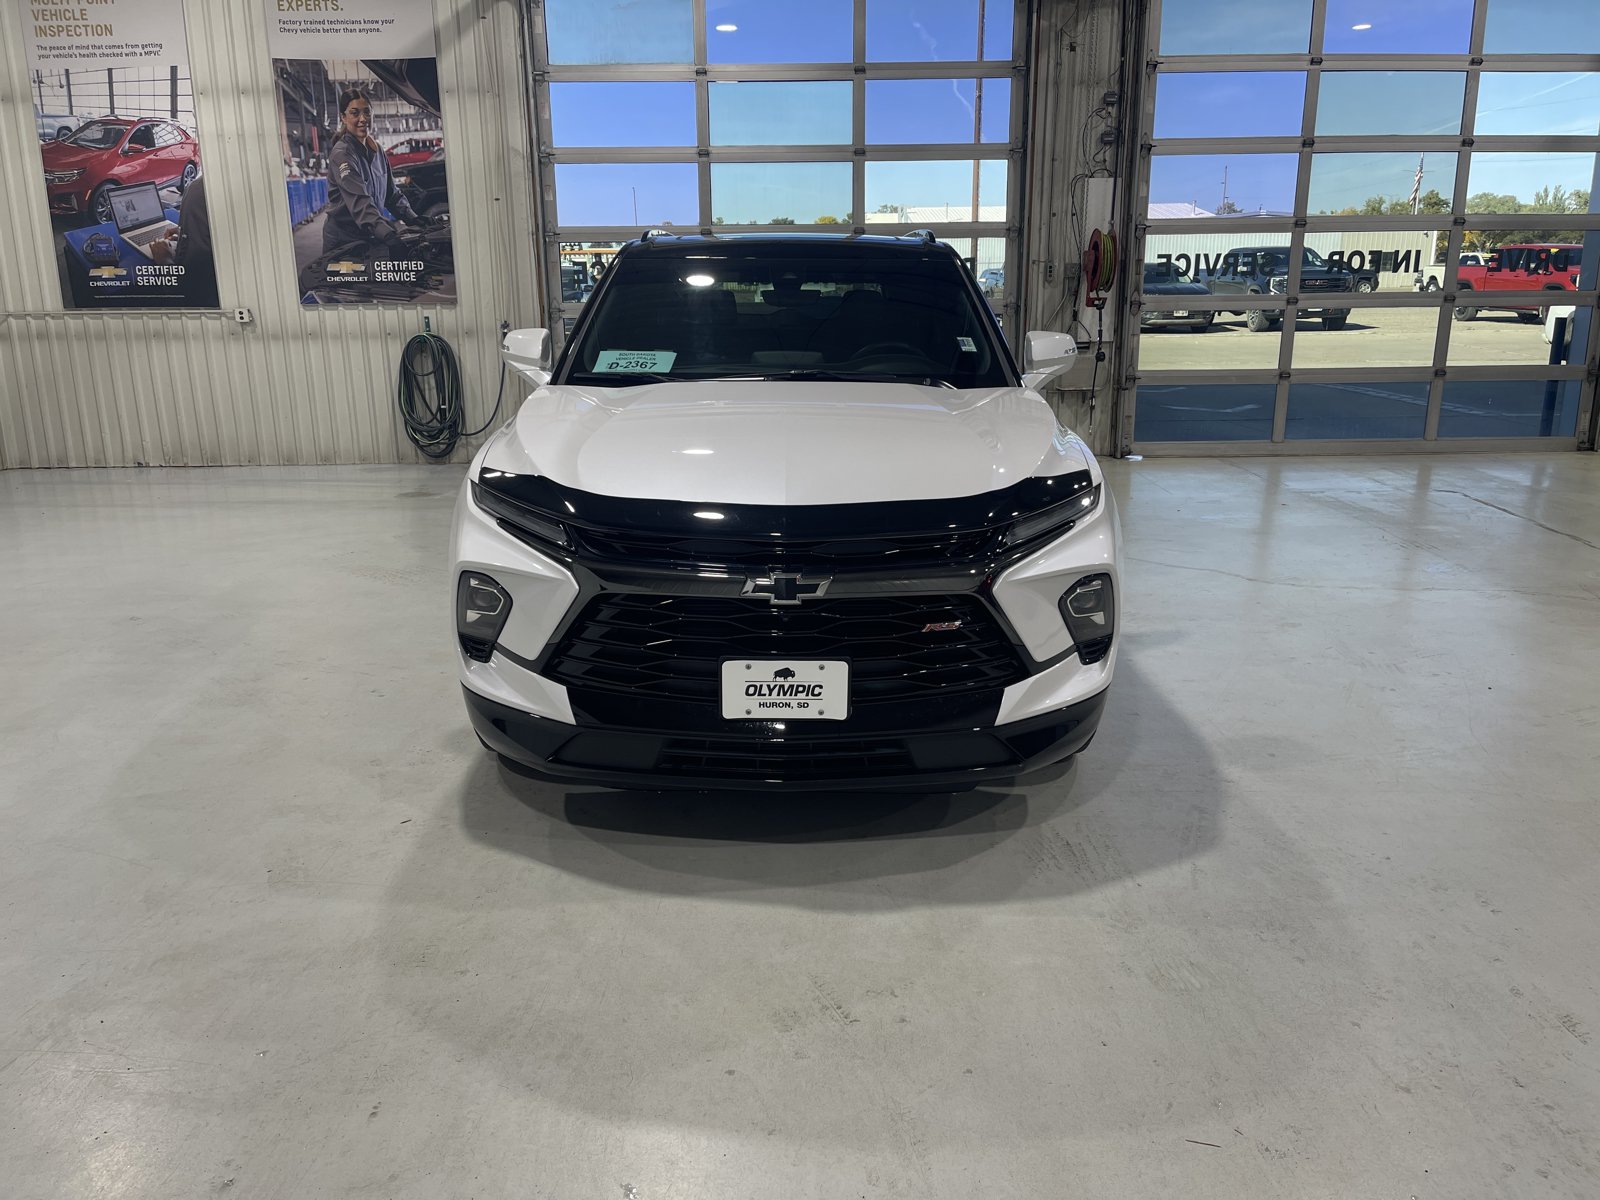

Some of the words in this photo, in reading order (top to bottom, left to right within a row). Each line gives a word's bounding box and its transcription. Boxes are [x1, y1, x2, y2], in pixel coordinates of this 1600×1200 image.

[277, 0, 344, 11] EXPERTS.
[31, 9, 89, 21] VEHICLE
[34, 24, 113, 38] INSPECTION
[141, 43, 163, 51] getting
[135, 265, 185, 275] CERTIFIED
[374, 261, 424, 271] CERTIFIED
[137, 276, 178, 286] SERVICE
[375, 271, 417, 281] SERVICE
[608, 360, 658, 370] D-2367
[744, 684, 824, 697] OLYMPIC
[758, 701, 794, 710] HURON,
[796, 701, 810, 709] SD
